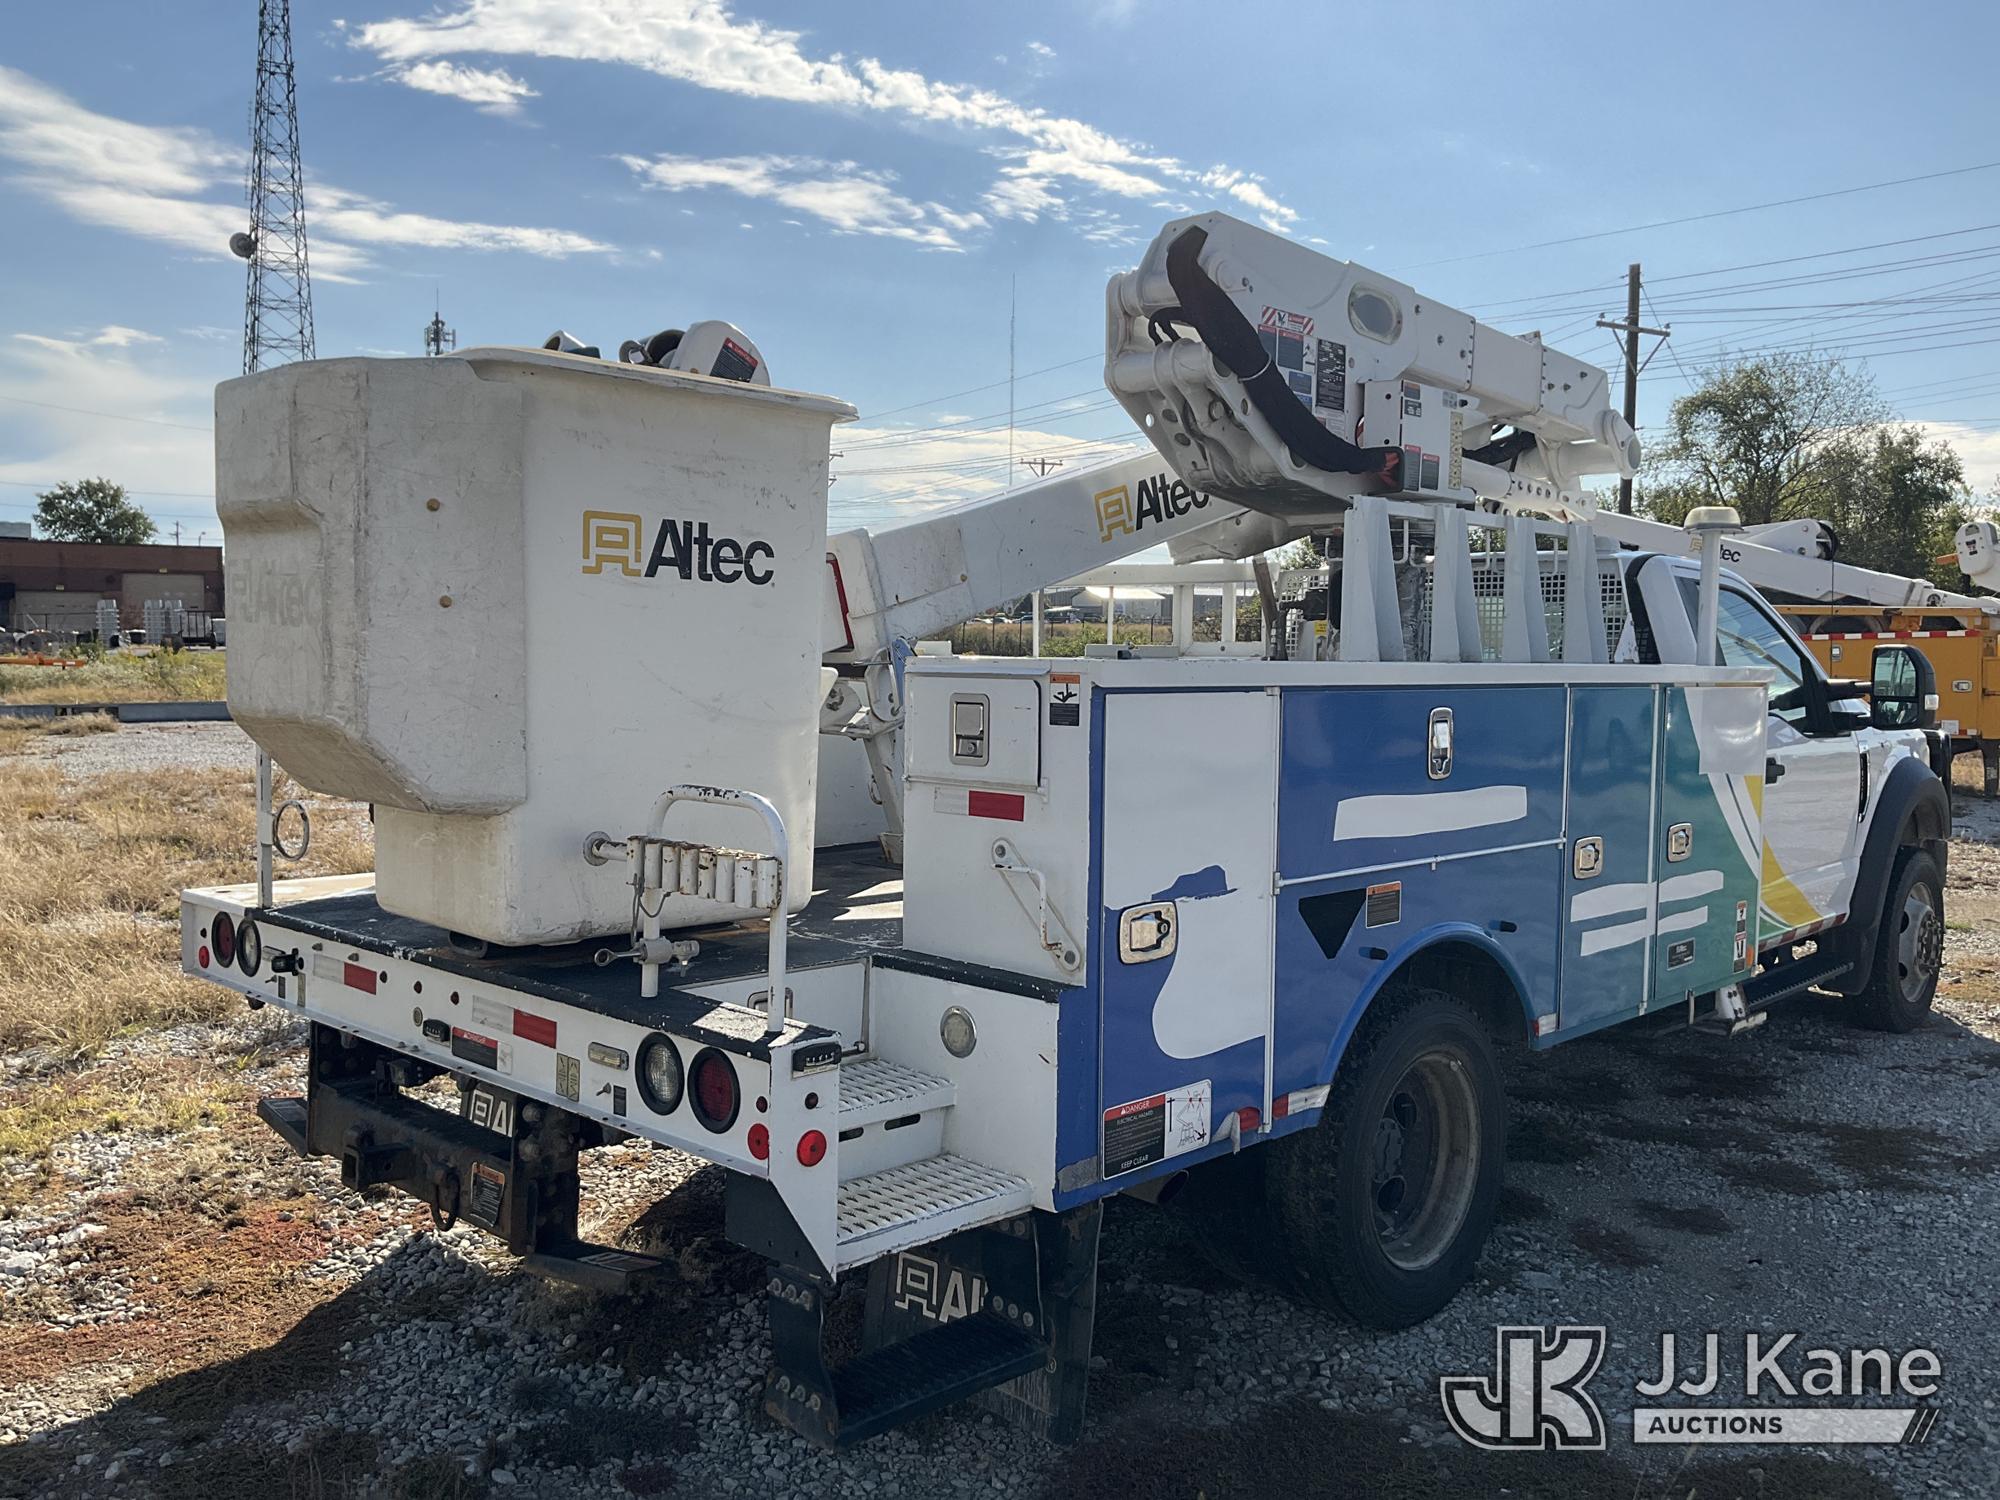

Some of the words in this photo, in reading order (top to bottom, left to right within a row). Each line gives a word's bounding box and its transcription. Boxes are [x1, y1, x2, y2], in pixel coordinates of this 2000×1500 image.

[644, 518, 775, 585] Altec
[1125, 1101, 1150, 1113] DANGER
[1120, 1159, 1133, 1169] KEEP
[1133, 1154, 1149, 1166] CLEAR
[939, 1270, 989, 1323] Al
